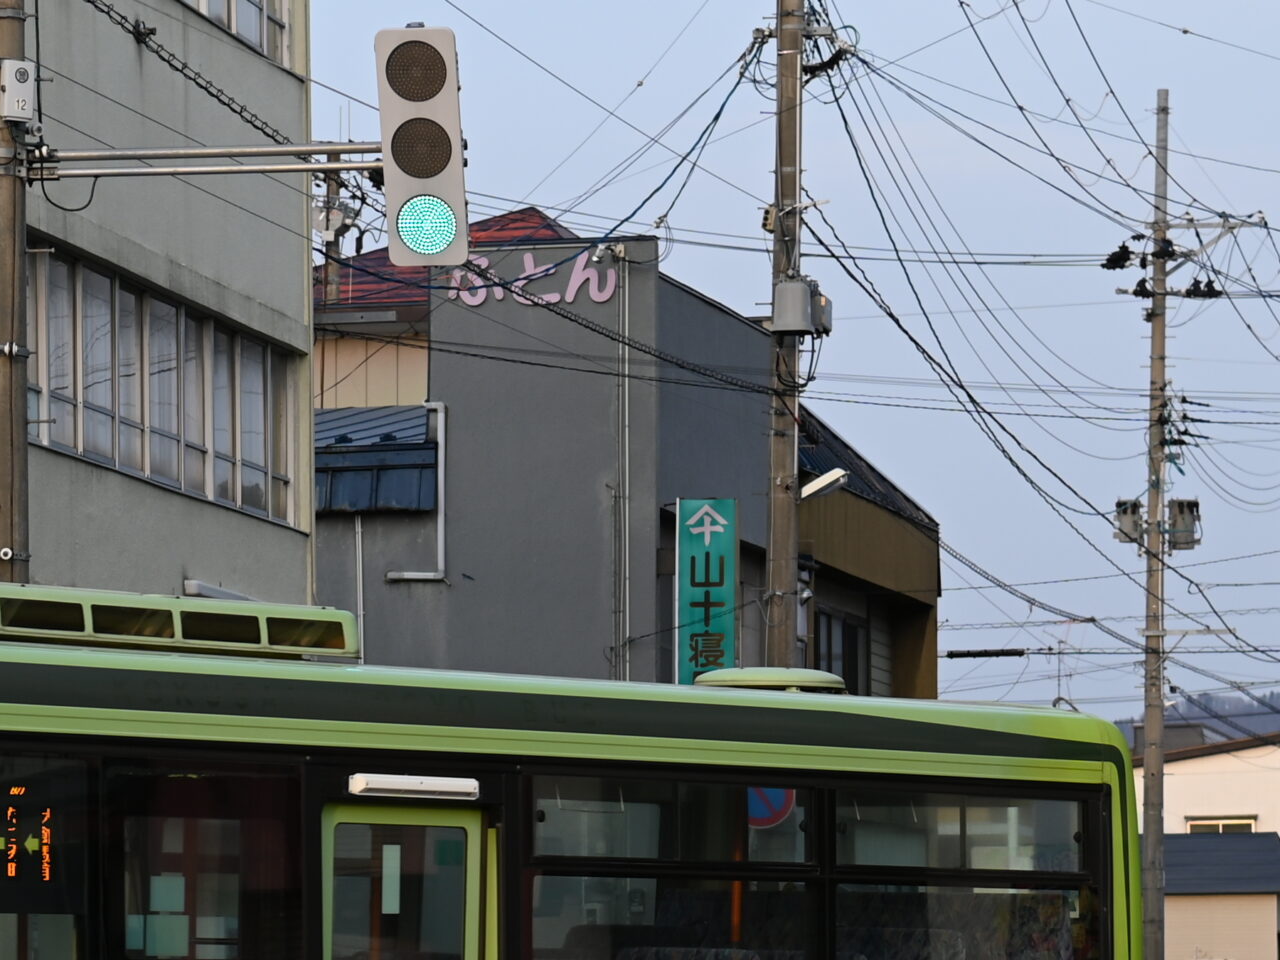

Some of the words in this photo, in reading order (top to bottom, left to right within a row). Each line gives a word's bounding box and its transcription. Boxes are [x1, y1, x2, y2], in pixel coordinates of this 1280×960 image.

[16, 98, 27, 111] 12
[448, 251, 617, 306] ふとん
[689, 551, 726, 686] 山十寝
